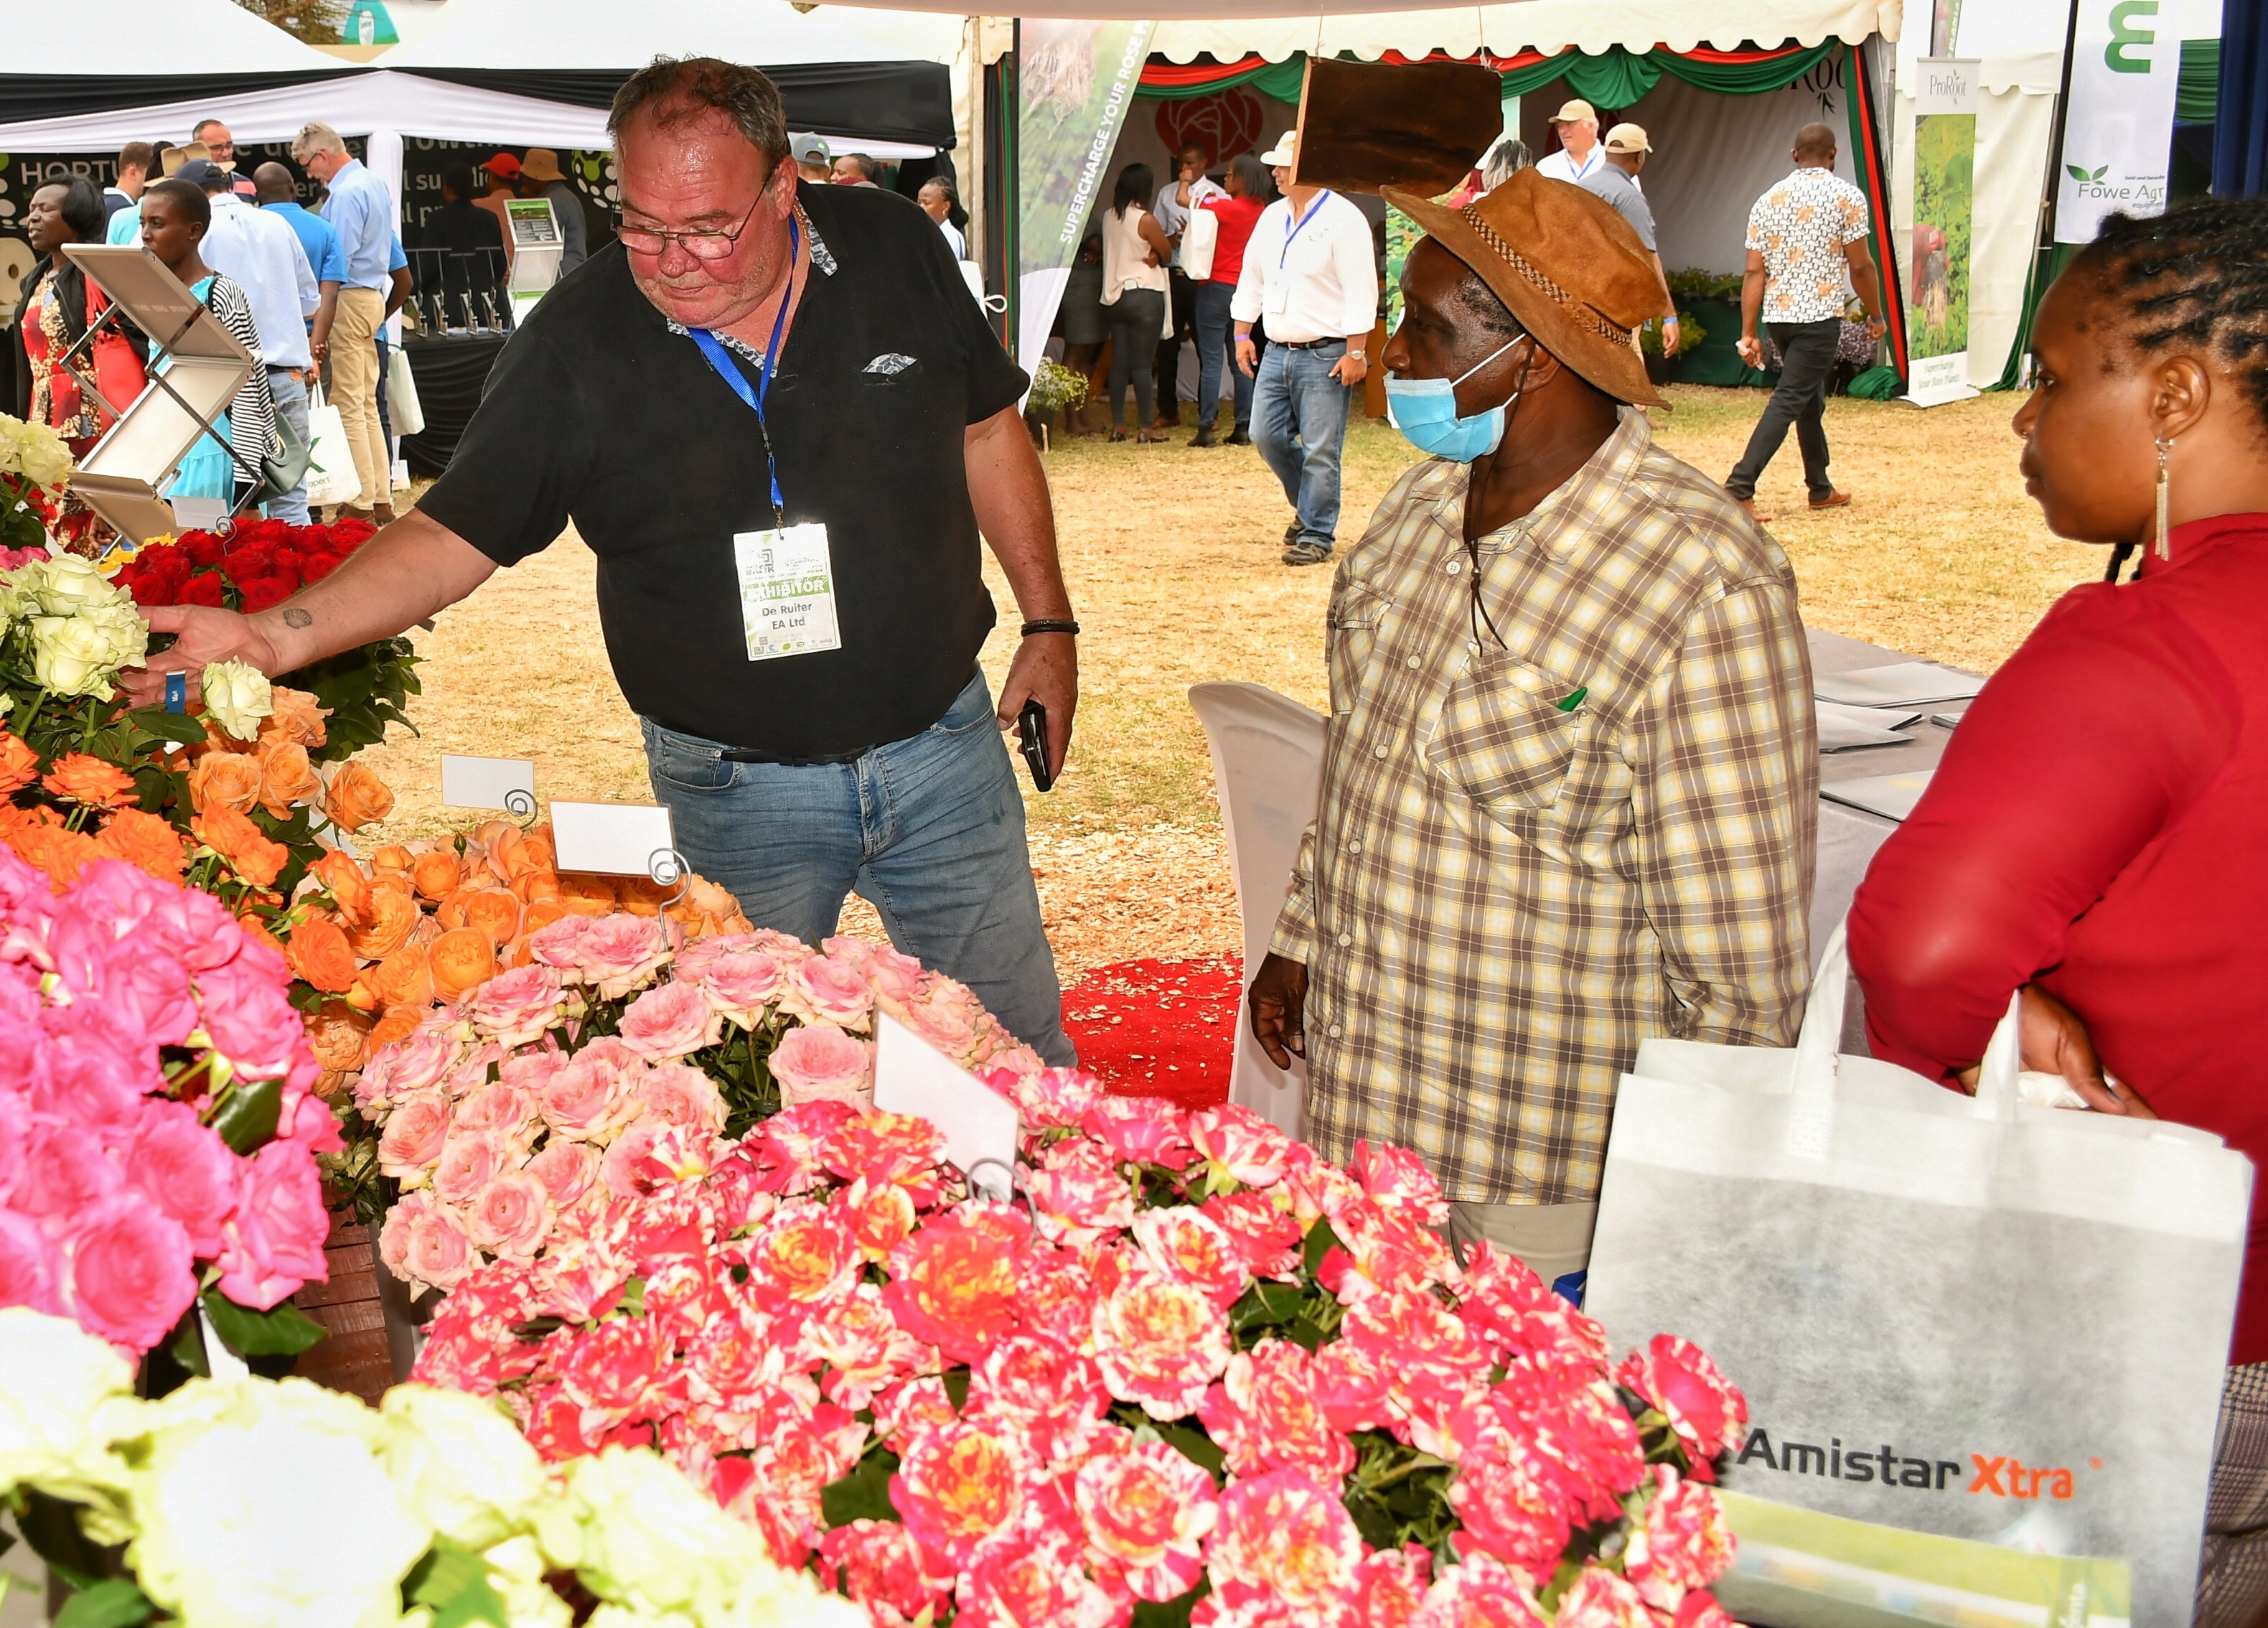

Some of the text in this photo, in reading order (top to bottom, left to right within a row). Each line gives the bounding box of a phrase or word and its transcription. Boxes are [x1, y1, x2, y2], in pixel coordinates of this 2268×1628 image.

[1930, 75, 1966, 96] ProRoot
[1060, 128, 1110, 245] SUPERCHARGE
[1100, 81, 1127, 126] YOUR
[1117, 32, 1143, 80] ROSE
[2079, 183, 2130, 199] Fowe
[762, 603, 812, 617] De Ruiter
[772, 617, 805, 630] EA Ltd
[1736, 1428, 2073, 1499] Amistar Xtra
